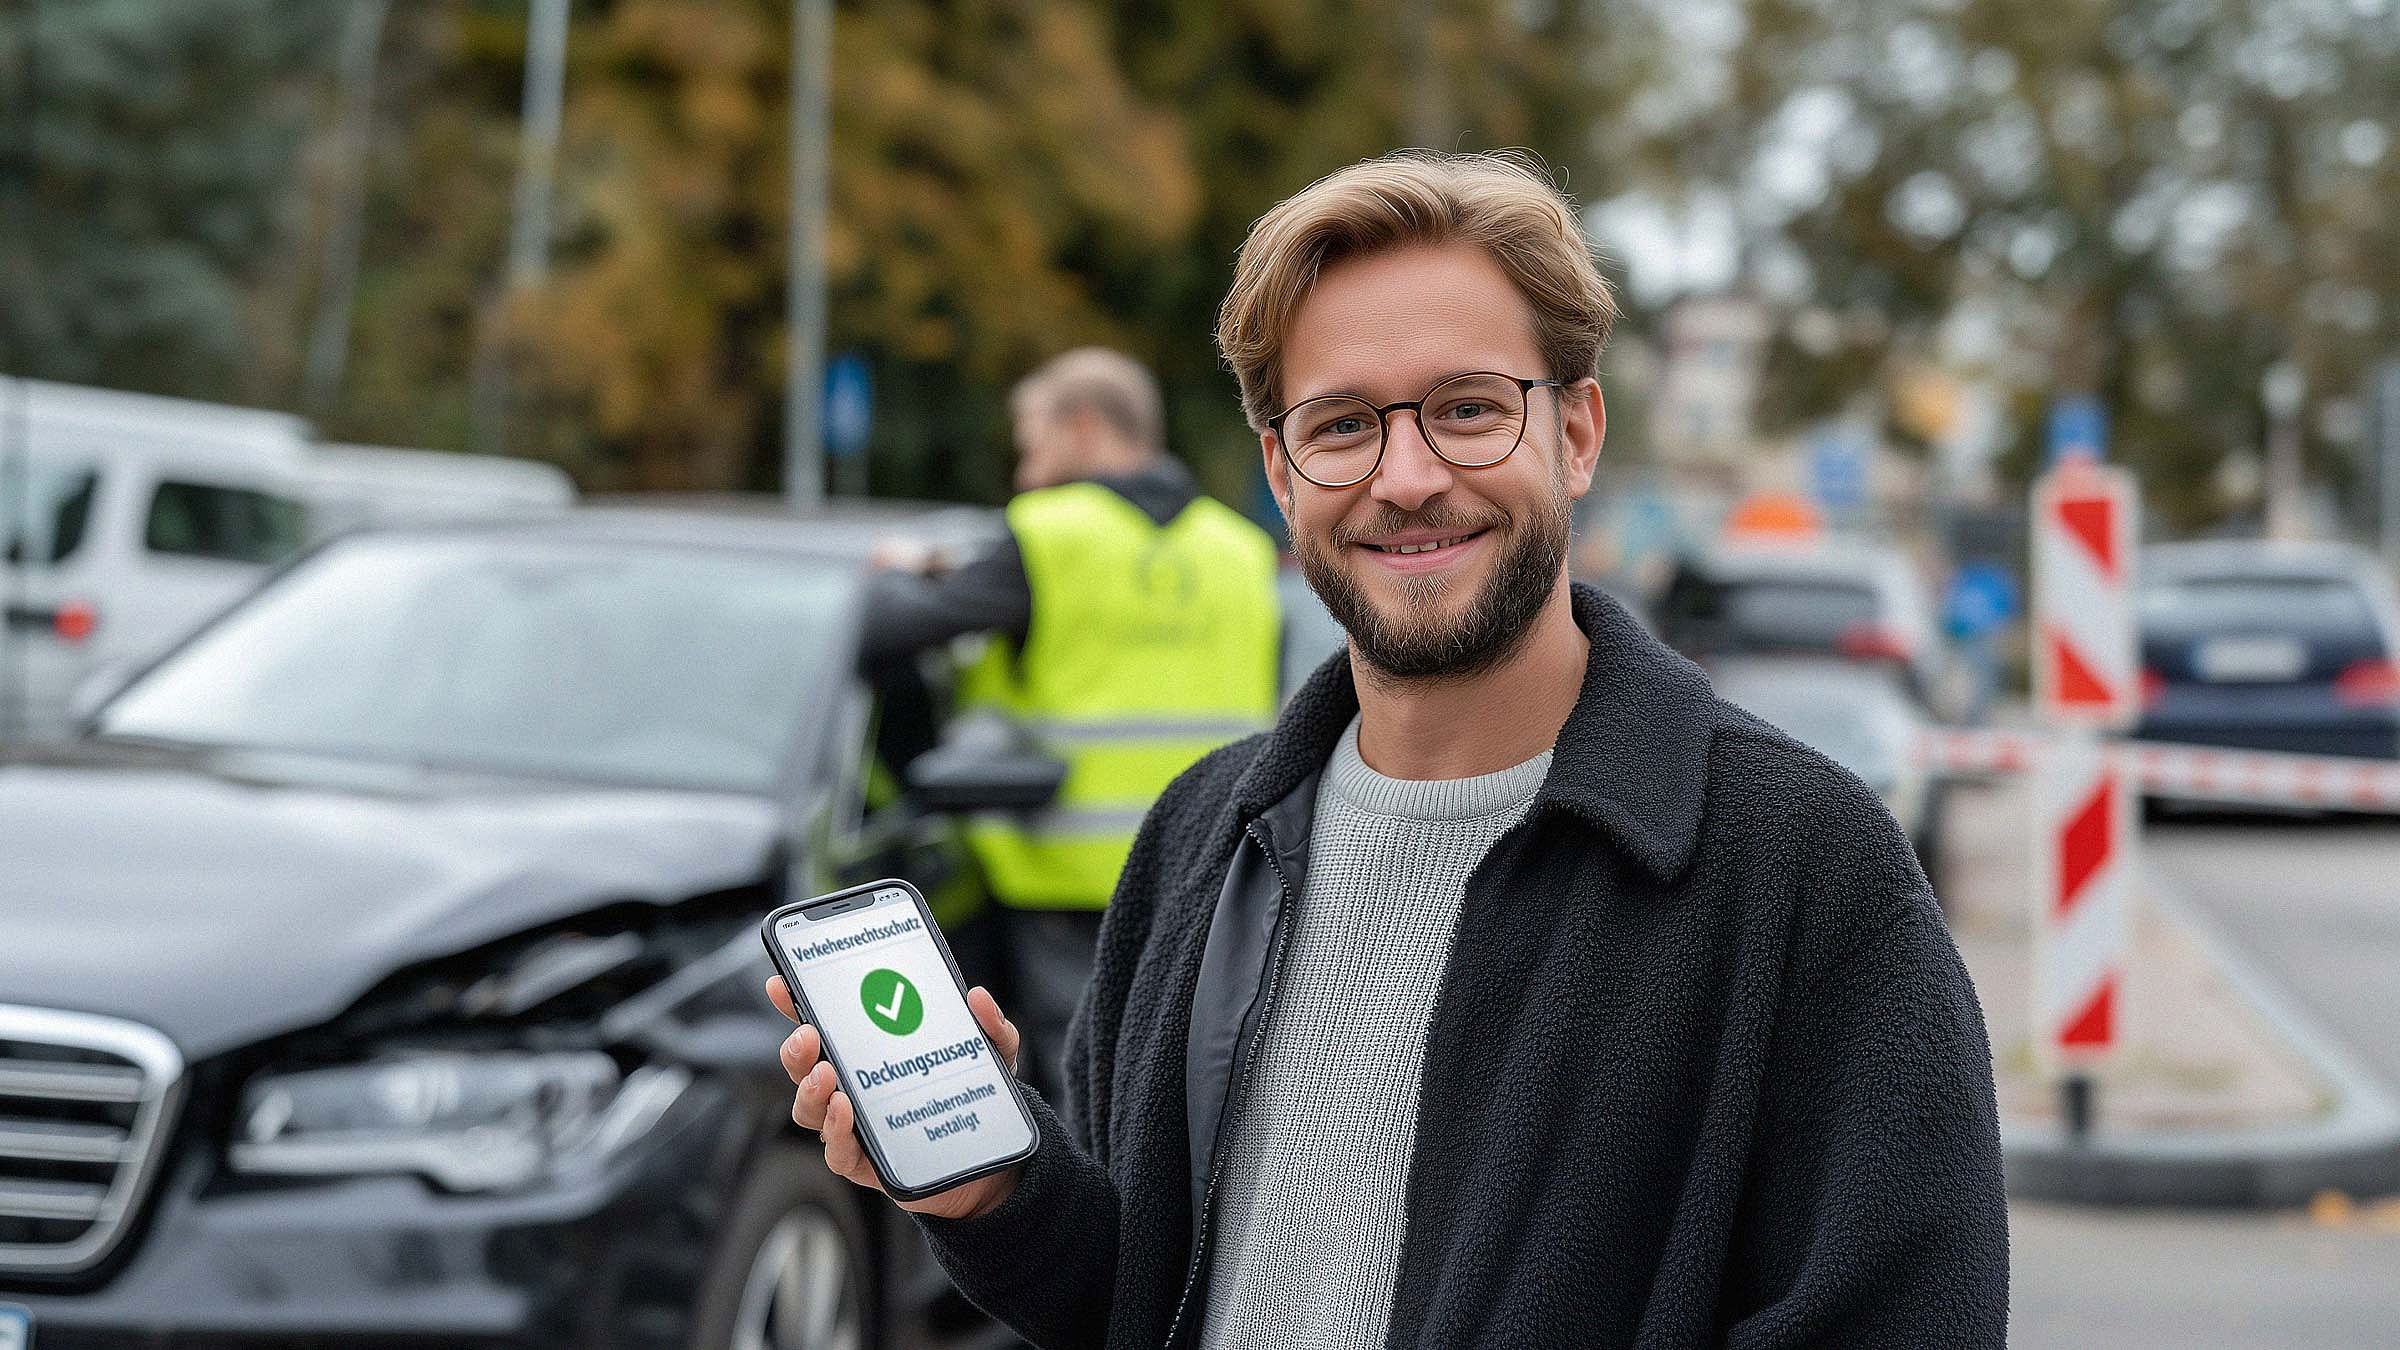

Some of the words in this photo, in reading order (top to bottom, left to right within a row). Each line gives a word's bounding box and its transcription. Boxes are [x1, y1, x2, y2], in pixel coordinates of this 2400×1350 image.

[792, 918, 921, 962] Verkehesrechtsschutz
[856, 1036, 985, 1090] Deckungszusage
[885, 1083, 997, 1130] Kostenübernahme
